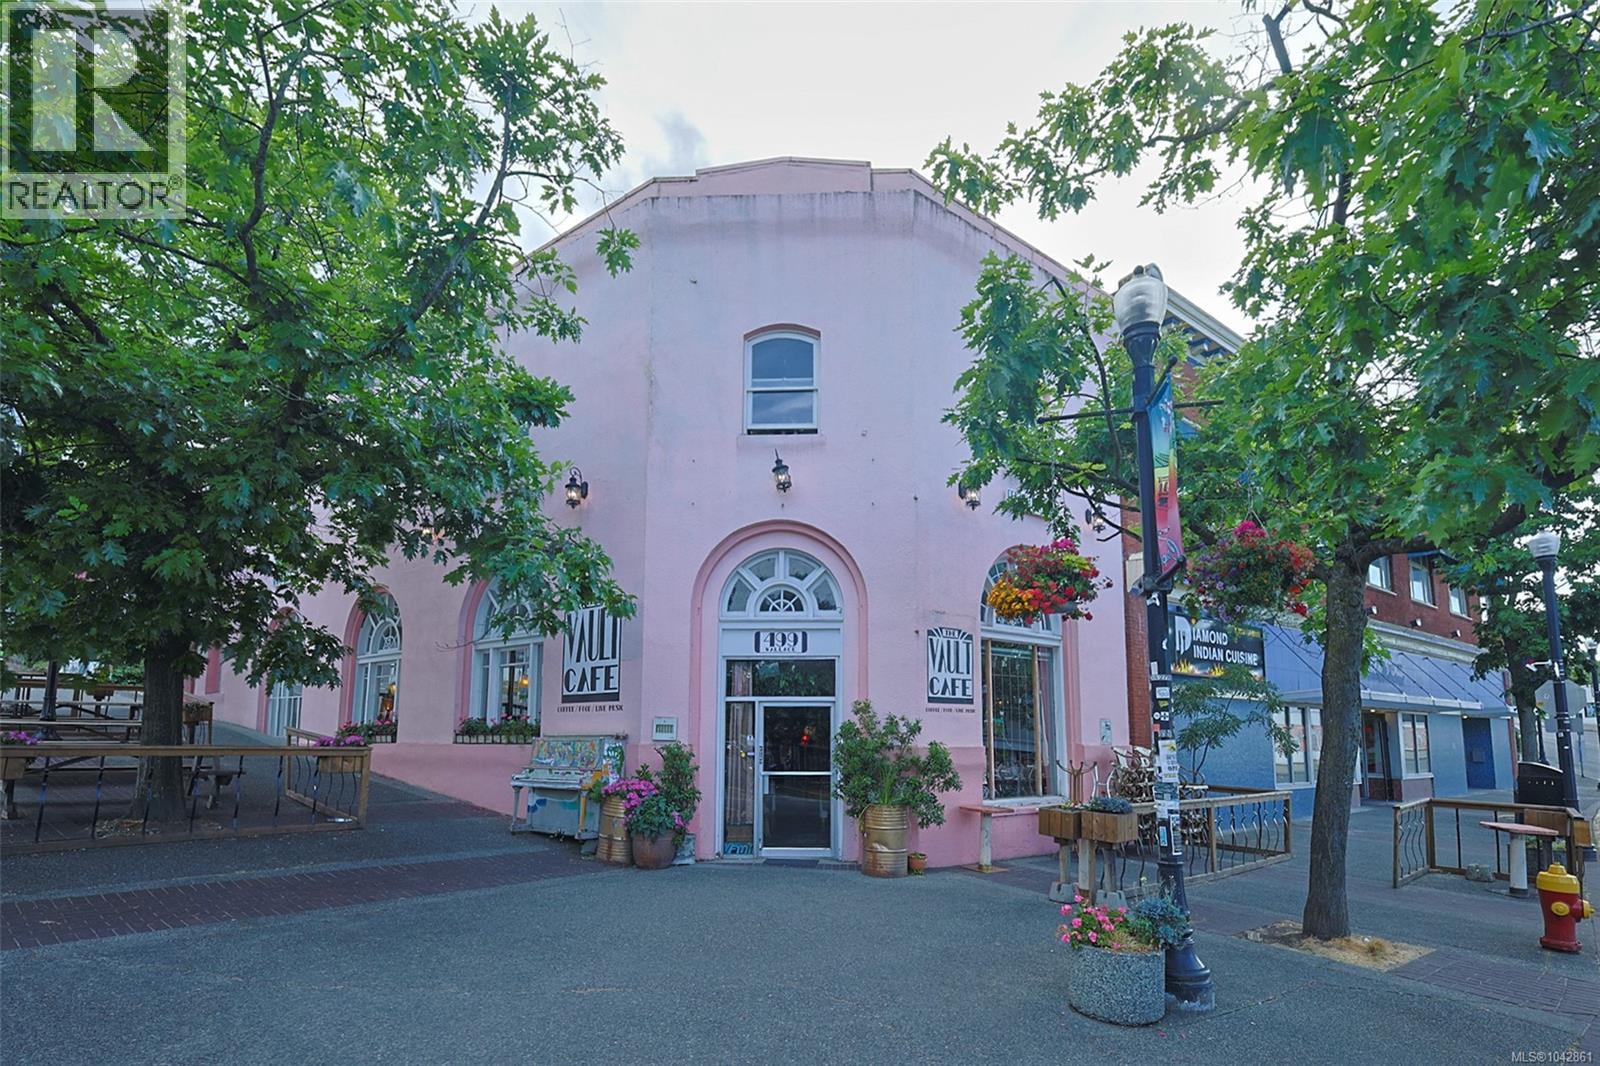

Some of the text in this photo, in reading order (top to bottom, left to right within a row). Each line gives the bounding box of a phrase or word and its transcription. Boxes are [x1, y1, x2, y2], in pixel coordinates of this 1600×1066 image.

[763, 632, 799, 647] 499
[929, 638, 972, 674] VAULT
[1193, 645, 1258, 666] INDIAN CUISINE
[564, 664, 618, 693] CAFE
[929, 677, 972, 697] CAFE
